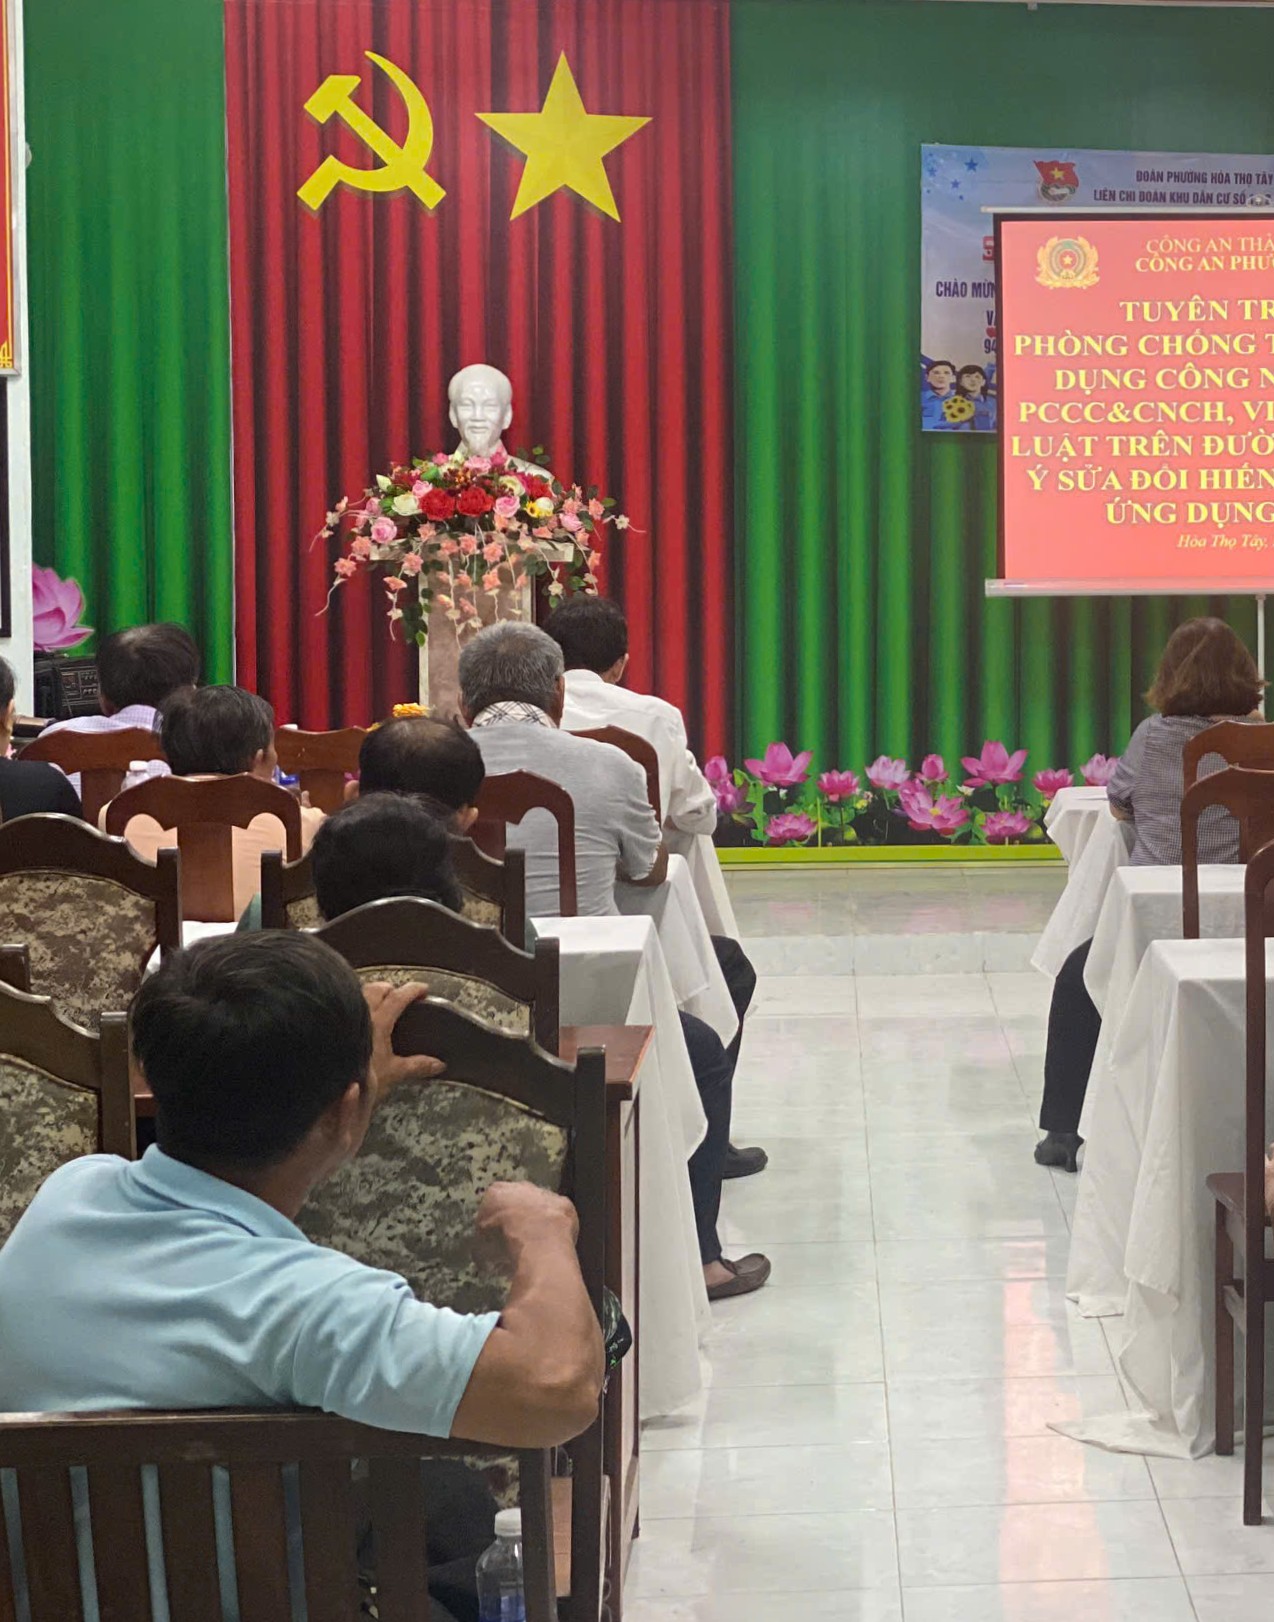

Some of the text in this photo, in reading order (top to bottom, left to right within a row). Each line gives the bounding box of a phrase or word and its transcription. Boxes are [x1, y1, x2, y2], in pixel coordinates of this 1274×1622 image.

[1136, 167, 1164, 183] ĐOÀN
[1166, 169, 1208, 184] PHƯỜNG
[1210, 169, 1231, 184] HÒA
[1255, 170, 1273, 185] TÂY
[1094, 187, 1116, 201] LIÊN
[1119, 190, 1136, 202] CHI
[1138, 188, 1165, 203] ĐOÀN
[1169, 191, 1190, 204] KHU
[1193, 189, 1213, 204] DÂN
[1216, 192, 1231, 204] CƯ
[1233, 188, 1246, 205] SỐ
[1146, 235, 1201, 253] CÔNG
[1205, 237, 1232, 252] AN
[1135, 252, 1193, 273] CÔNG
[1198, 256, 1225, 271] AN
[936, 278, 996, 298] CHÀO MỪN
[1120, 296, 1229, 322] TUYÊN
[1014, 328, 1128, 357] PHÒNG
[1138, 328, 1256, 355] CHỐNG
[1055, 367, 1146, 395] DỤNG
[1156, 362, 1250, 390] CÔNG
[1019, 400, 1235, 426] PCCC&CNCH,
[1012, 434, 1099, 462] LUẬT
[1107, 430, 1193, 456] TRÊN
[1027, 468, 1049, 491] Ý
[1058, 463, 1123, 491] SỬA
[1131, 463, 1188, 491] ĐỔI
[1105, 496, 1178, 524] ỨNG
[1177, 534, 1206, 548] Hòa
[1211, 534, 1237, 549] Thọ
